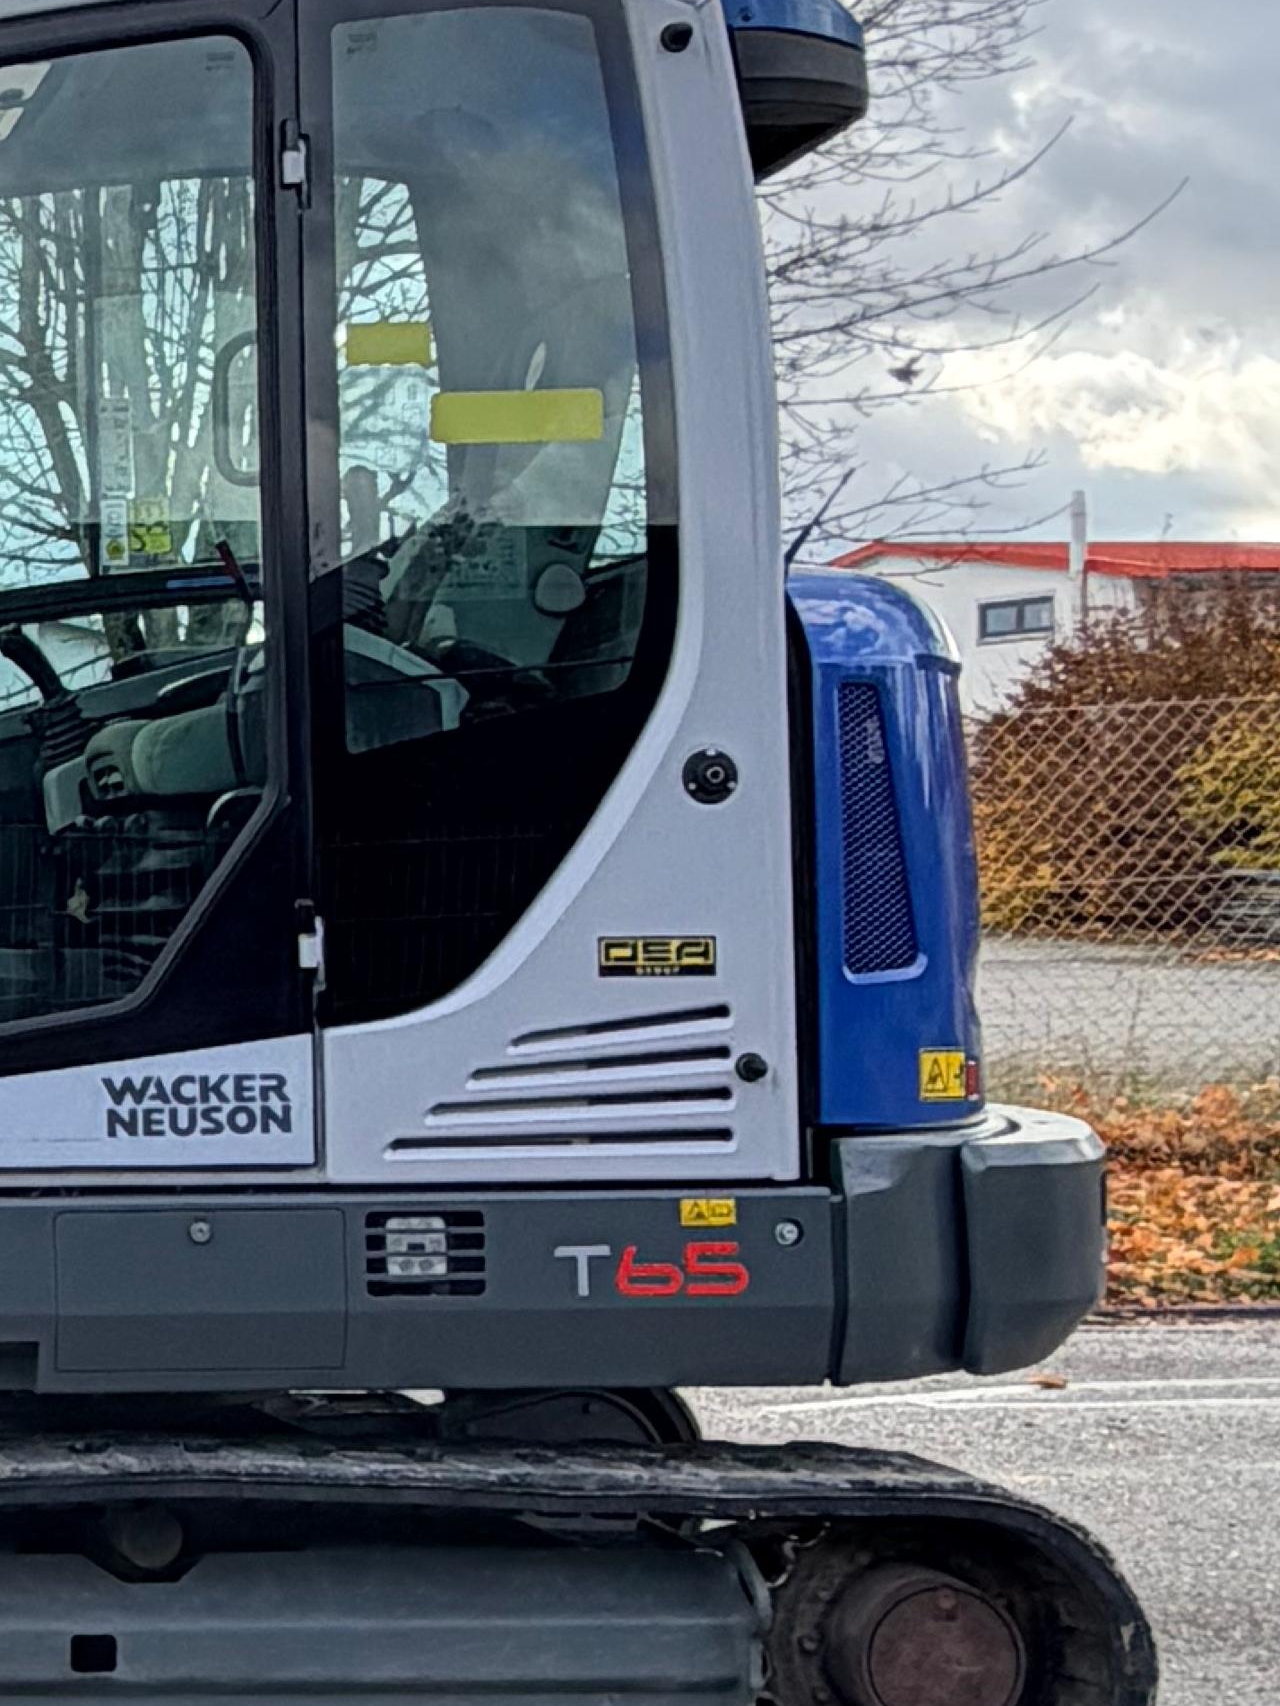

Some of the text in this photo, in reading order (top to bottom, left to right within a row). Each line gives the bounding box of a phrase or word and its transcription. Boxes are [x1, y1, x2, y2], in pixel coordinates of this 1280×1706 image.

[101, 1073, 290, 1106] WACKER
[107, 1104, 293, 1138] NEUSON
[554, 1242, 749, 1297] T65
